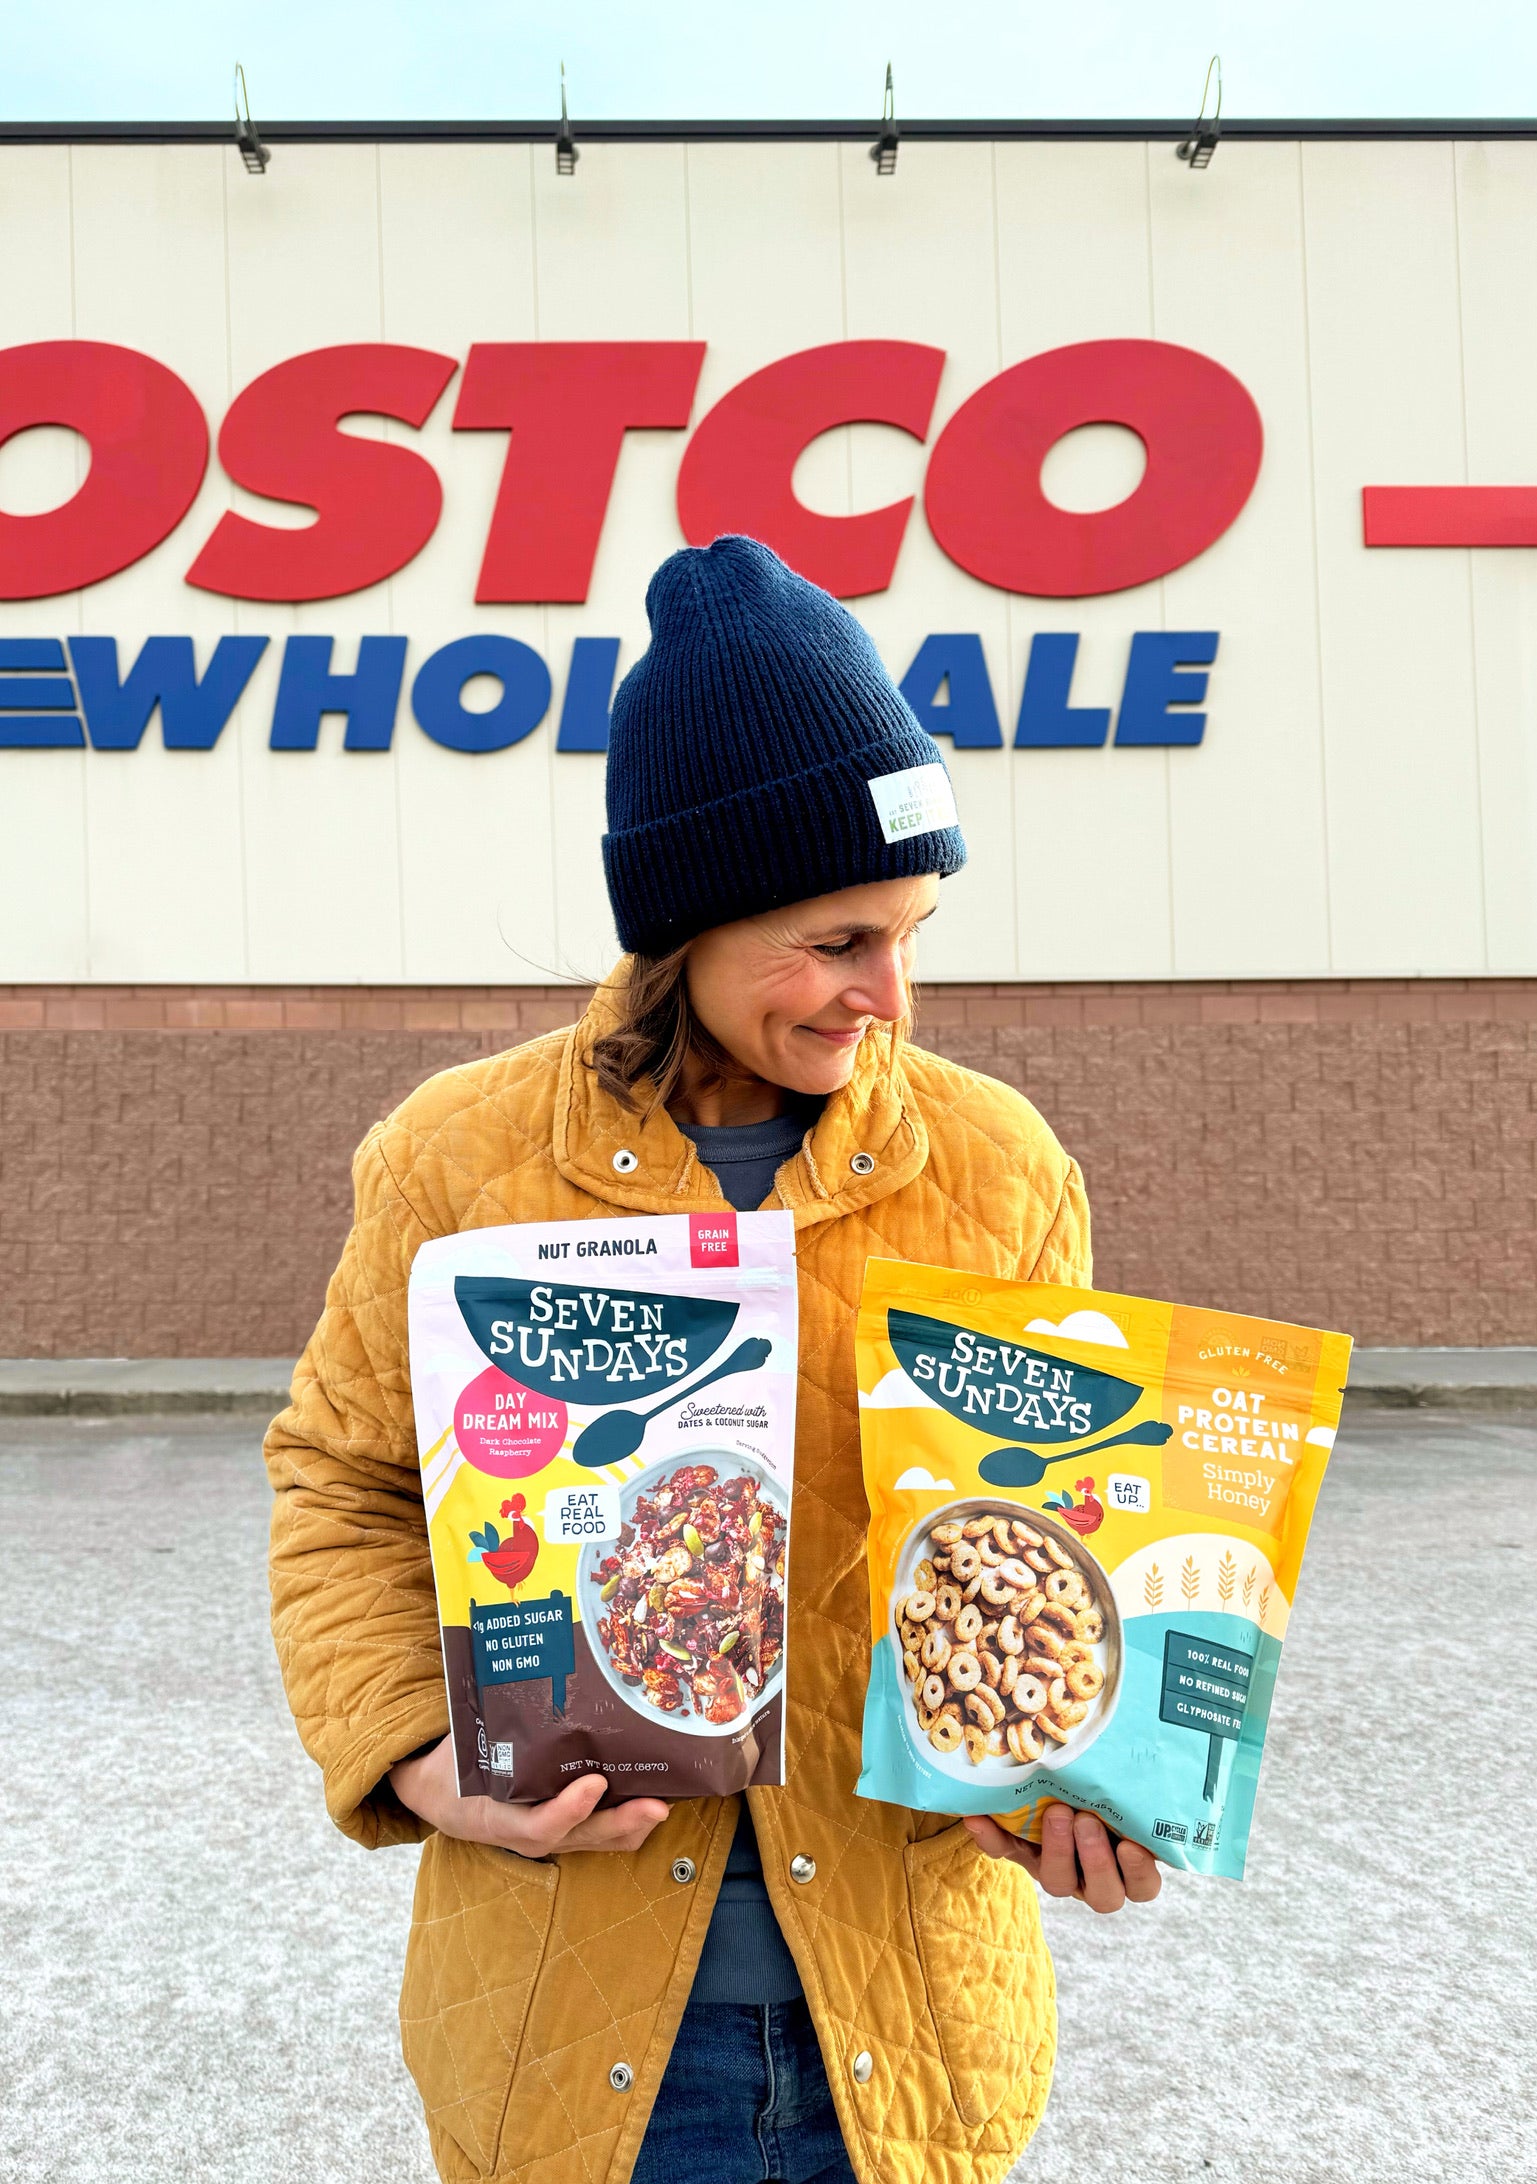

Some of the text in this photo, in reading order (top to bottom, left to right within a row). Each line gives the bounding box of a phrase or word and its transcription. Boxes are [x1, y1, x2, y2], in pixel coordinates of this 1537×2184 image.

[67, 631, 1220, 754] WHOLALE
[888, 811, 923, 833] KEEP
[697, 1229, 729, 1239] GRAIN
[538, 1238, 658, 1260] NUT GRANOLA
[701, 1241, 727, 1252] FREE
[529, 1286, 664, 1333] SEVEN
[489, 1320, 688, 1382] SUNDAYS
[951, 1331, 1074, 1393] SEVEN
[1198, 1345, 1250, 1360] GLUTEN
[1255, 1351, 1289, 1375] FREE
[495, 1392, 527, 1411] DAY
[912, 1353, 1092, 1434] SUNDAYS
[1212, 1387, 1266, 1415] OAT
[463, 1412, 559, 1430] DREAM MIX
[680, 1402, 767, 1420] Sweetened with
[678, 1418, 769, 1429] DATES & COCONUT SUGAR
[1178, 1405, 1299, 1440] PROTEIN
[480, 1437, 500, 1445] Dark
[1182, 1430, 1294, 1465] CEREAL
[489, 1448, 532, 1457] Raspberry
[1114, 1482, 1142, 1495] EAT
[1203, 1463, 1276, 1495] Simply
[567, 1493, 597, 1506] EAT
[1207, 1482, 1271, 1517] Honey
[560, 1505, 604, 1520] REAL
[562, 1520, 606, 1535] FOOD
[486, 1615, 521, 1631] ADDED
[524, 1609, 563, 1625] SUGAR
[485, 1633, 544, 1652] NO GLUTEN
[492, 1655, 540, 1672] NON GMO
[1187, 1649, 1210, 1664] 100%
[1211, 1656, 1232, 1672] REAL
[1179, 1674, 1194, 1687] NO
[1195, 1679, 1230, 1698] REFINED
[1176, 1702, 1231, 1727] GLYPHOSATE
[560, 1760, 583, 1772] NET
[584, 1759, 600, 1769] WT
[602, 1763, 616, 1772] 20
[617, 1763, 633, 1771] OZ
[1014, 1781, 1034, 1795] NET
[1037, 1778, 1055, 1786] WT
